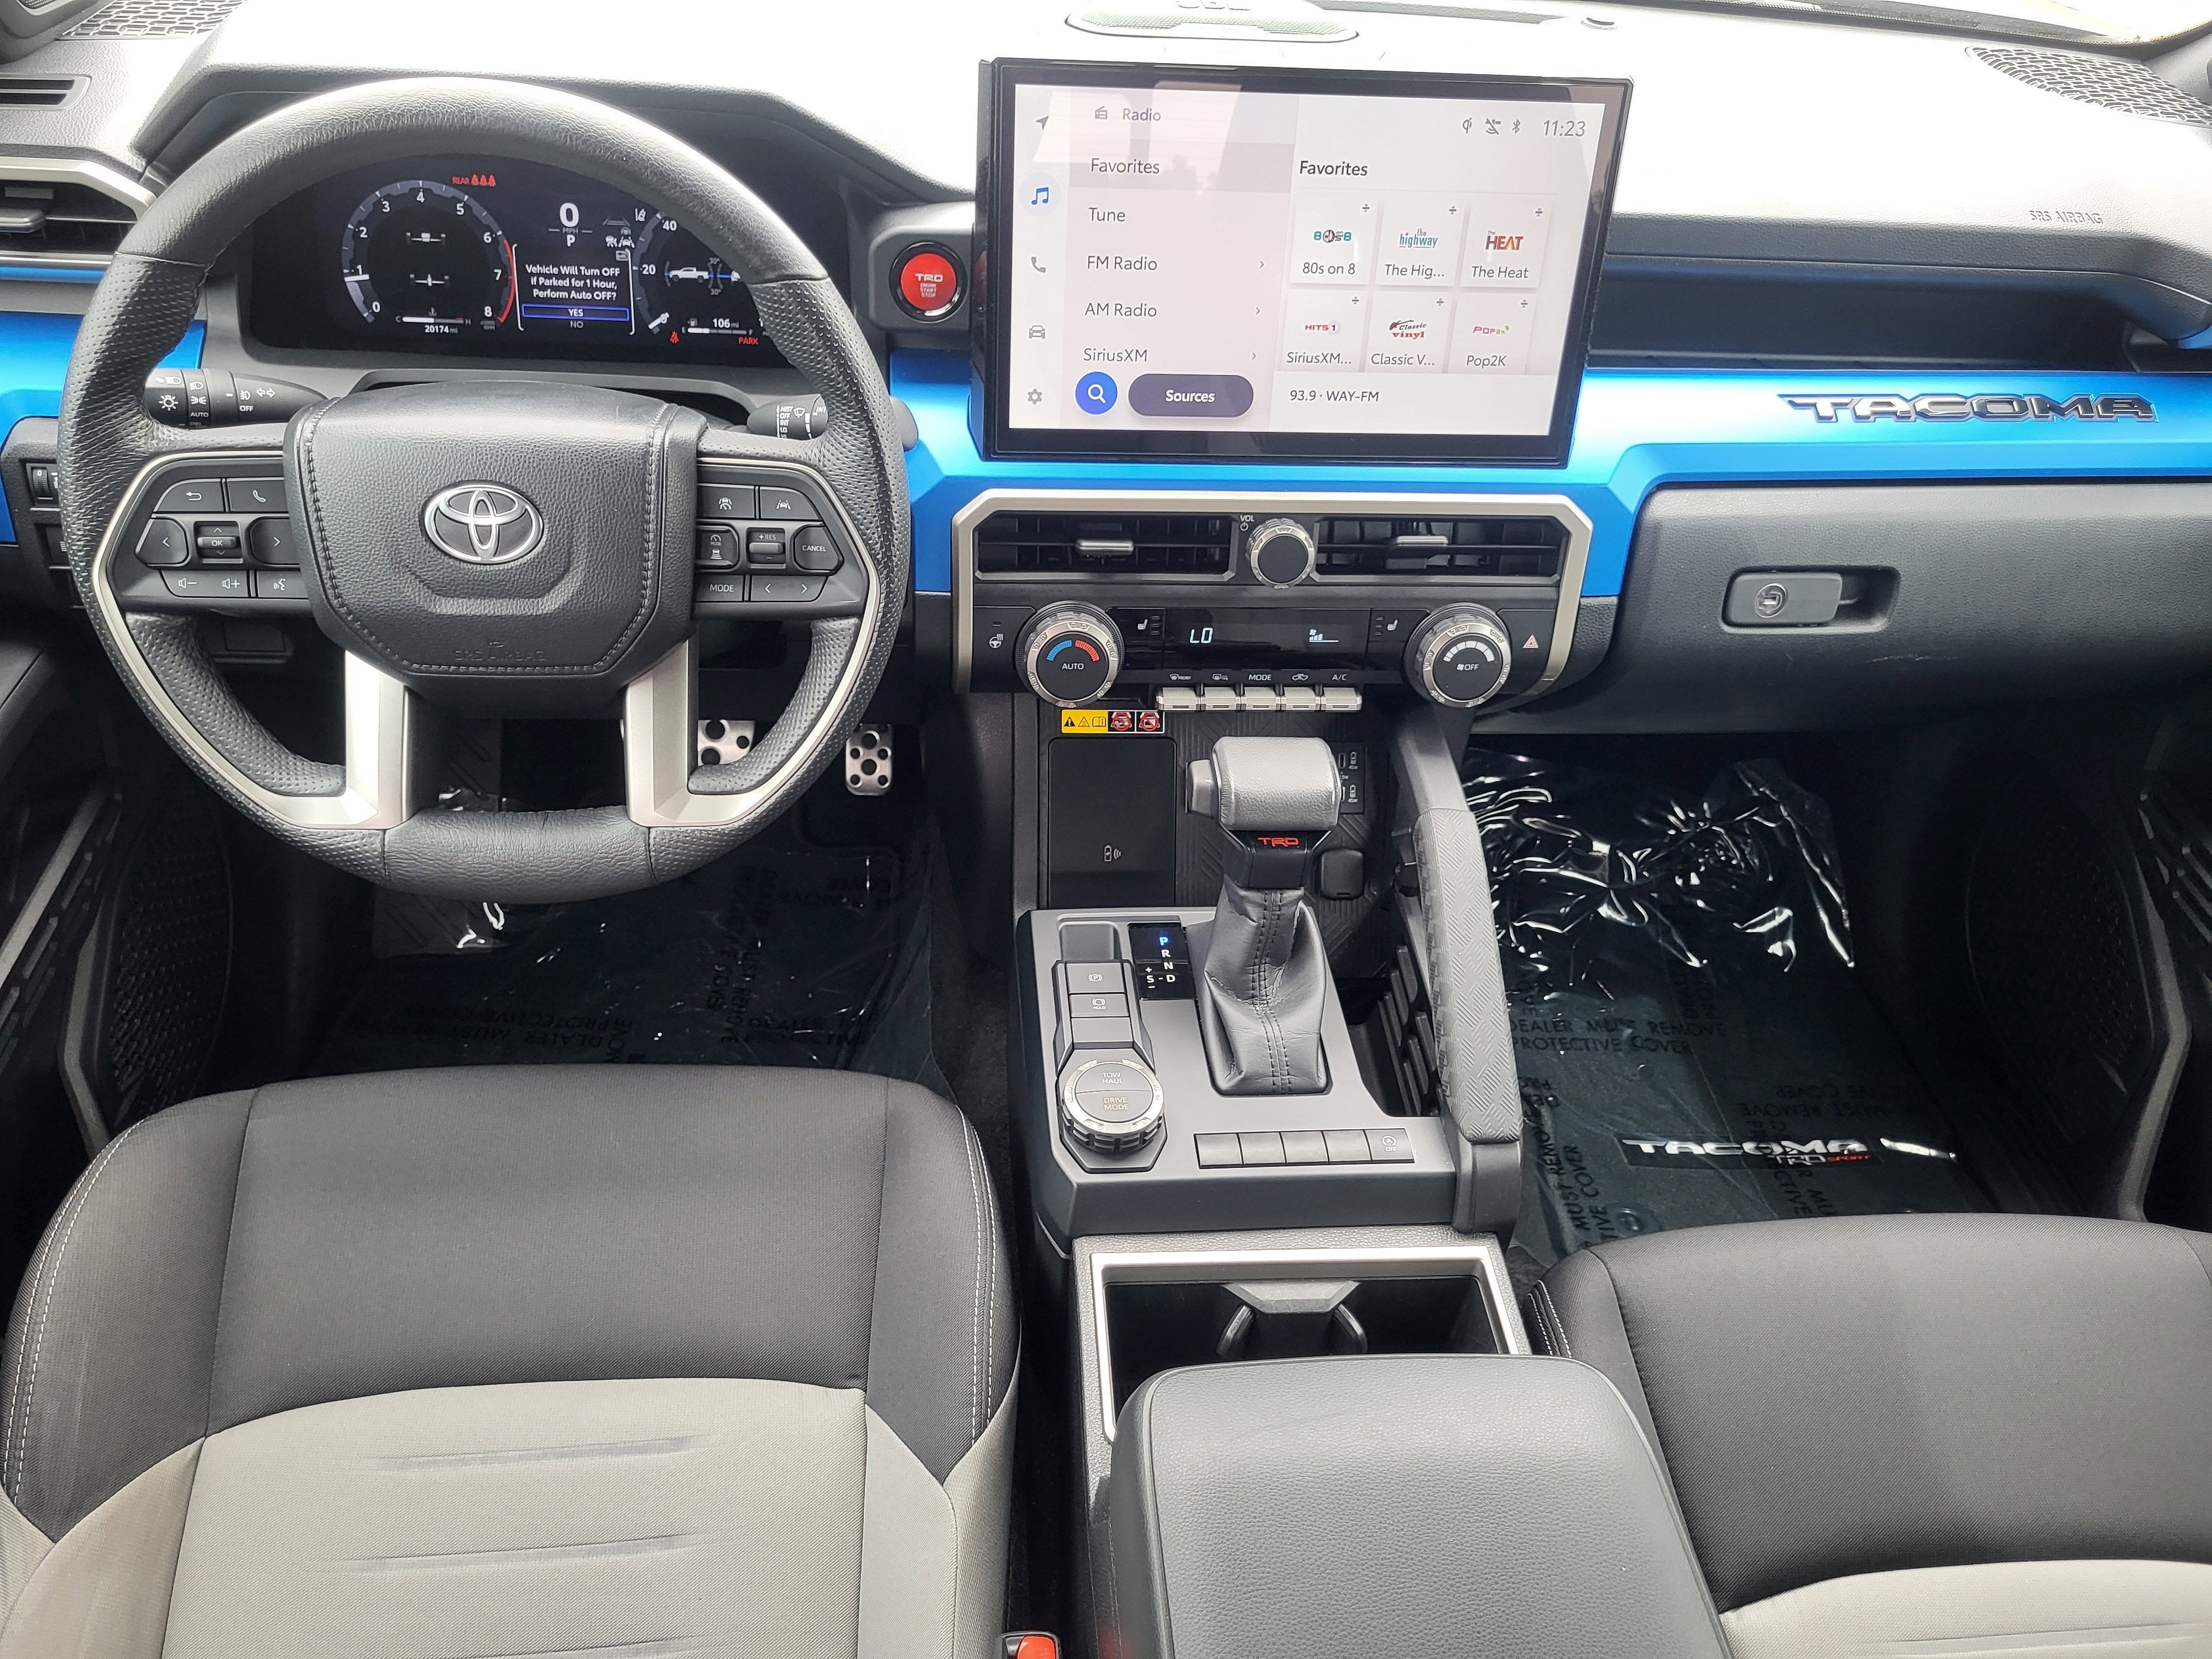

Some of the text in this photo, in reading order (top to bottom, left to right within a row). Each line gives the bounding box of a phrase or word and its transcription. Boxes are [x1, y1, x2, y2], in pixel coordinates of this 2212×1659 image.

[1122, 108, 1161, 121] Radio
[1543, 120, 1586, 137] 11:23
[1091, 158, 1160, 174] Favorites
[1298, 160, 1368, 177] Favorites
[452, 176, 469, 185] REAR
[416, 192, 425, 203] 4
[382, 201, 390, 212] 3
[456, 203, 465, 215] 5
[559, 202, 580, 227] 0
[1088, 207, 1126, 222] Tune
[2055, 211, 2104, 225] AIRBAG
[662, 220, 677, 231] 40
[359, 226, 368, 238] 2
[483, 232, 492, 243] 6
[566, 234, 576, 247] P
[1399, 233, 1438, 249] highway
[1485, 235, 1524, 251] HEAT
[1087, 255, 1158, 270] FM Radio
[1302, 262, 1355, 275] 80s on 8
[493, 269, 502, 280] 7
[525, 264, 620, 277] Vehicle Will Turn OFF
[641, 264, 656, 275] 20
[1384, 263, 1408, 276] The
[1472, 265, 1529, 279] The Heat
[530, 276, 618, 291] If Parked for 1 Hour,
[914, 273, 943, 283] TRD
[533, 289, 617, 301] Perform Auto OFF?
[372, 301, 380, 312] 0
[484, 306, 493, 317] 8
[568, 308, 584, 317] YES
[1084, 302, 1157, 317] AM Radio
[570, 320, 584, 329] NO
[712, 317, 731, 328] 106
[424, 325, 450, 333] 20174
[738, 337, 759, 346] PARK
[1392, 331, 1425, 340] vinyl
[1083, 348, 1147, 362] SiriusXM
[1286, 352, 1352, 364] SiriusXM...
[1371, 353, 1414, 365] Classic
[1466, 355, 1507, 369] Pop2K
[1165, 389, 1215, 403] Sources
[1290, 390, 1379, 402] 93.9 WAY-FM
[1777, 393, 2159, 423] TACOMA
[211, 539, 223, 547] OK
[709, 583, 734, 593] MODE
[1190, 627, 1214, 644] LO
[1061, 662, 1084, 671] AUTO
[1464, 663, 1479, 672] OFF
[1257, 837, 1299, 847] TRD
[1159, 936, 1168, 946] P
[1161, 949, 1171, 958] R
[1163, 961, 1174, 970] N
[1146, 974, 1176, 983] S D
[1512, 1035, 1693, 1055] PROTECTIVE COVER
[1622, 1139, 1868, 1155] TACOMA
[1563, 1145, 1599, 1198] COVER
